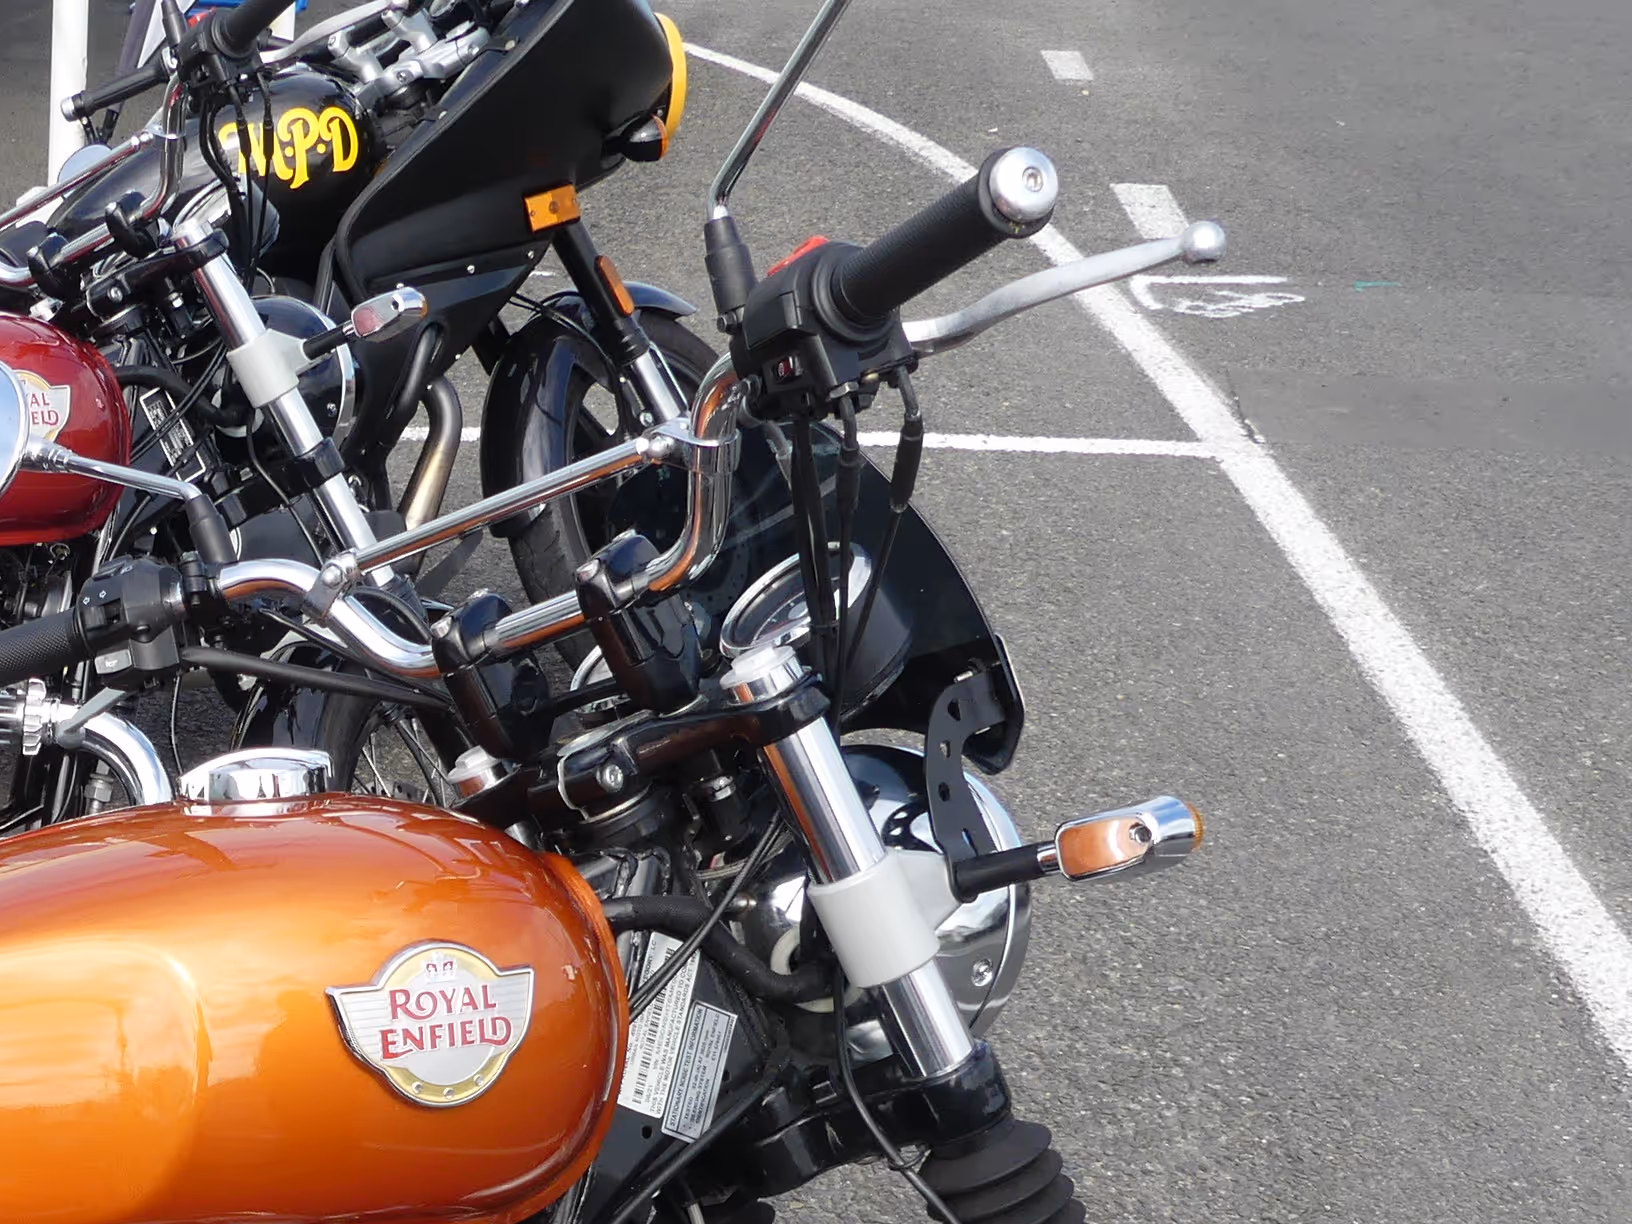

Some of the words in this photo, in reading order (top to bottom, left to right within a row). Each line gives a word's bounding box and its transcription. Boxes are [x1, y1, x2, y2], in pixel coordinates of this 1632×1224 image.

[388, 984, 498, 1021] ROYAL
[379, 1016, 512, 1060] ENFIELD
[653, 1065, 665, 1094] VEHICLE
[669, 1089, 683, 1126] STATIONARY
[688, 1008, 703, 1050] INFORMATION
